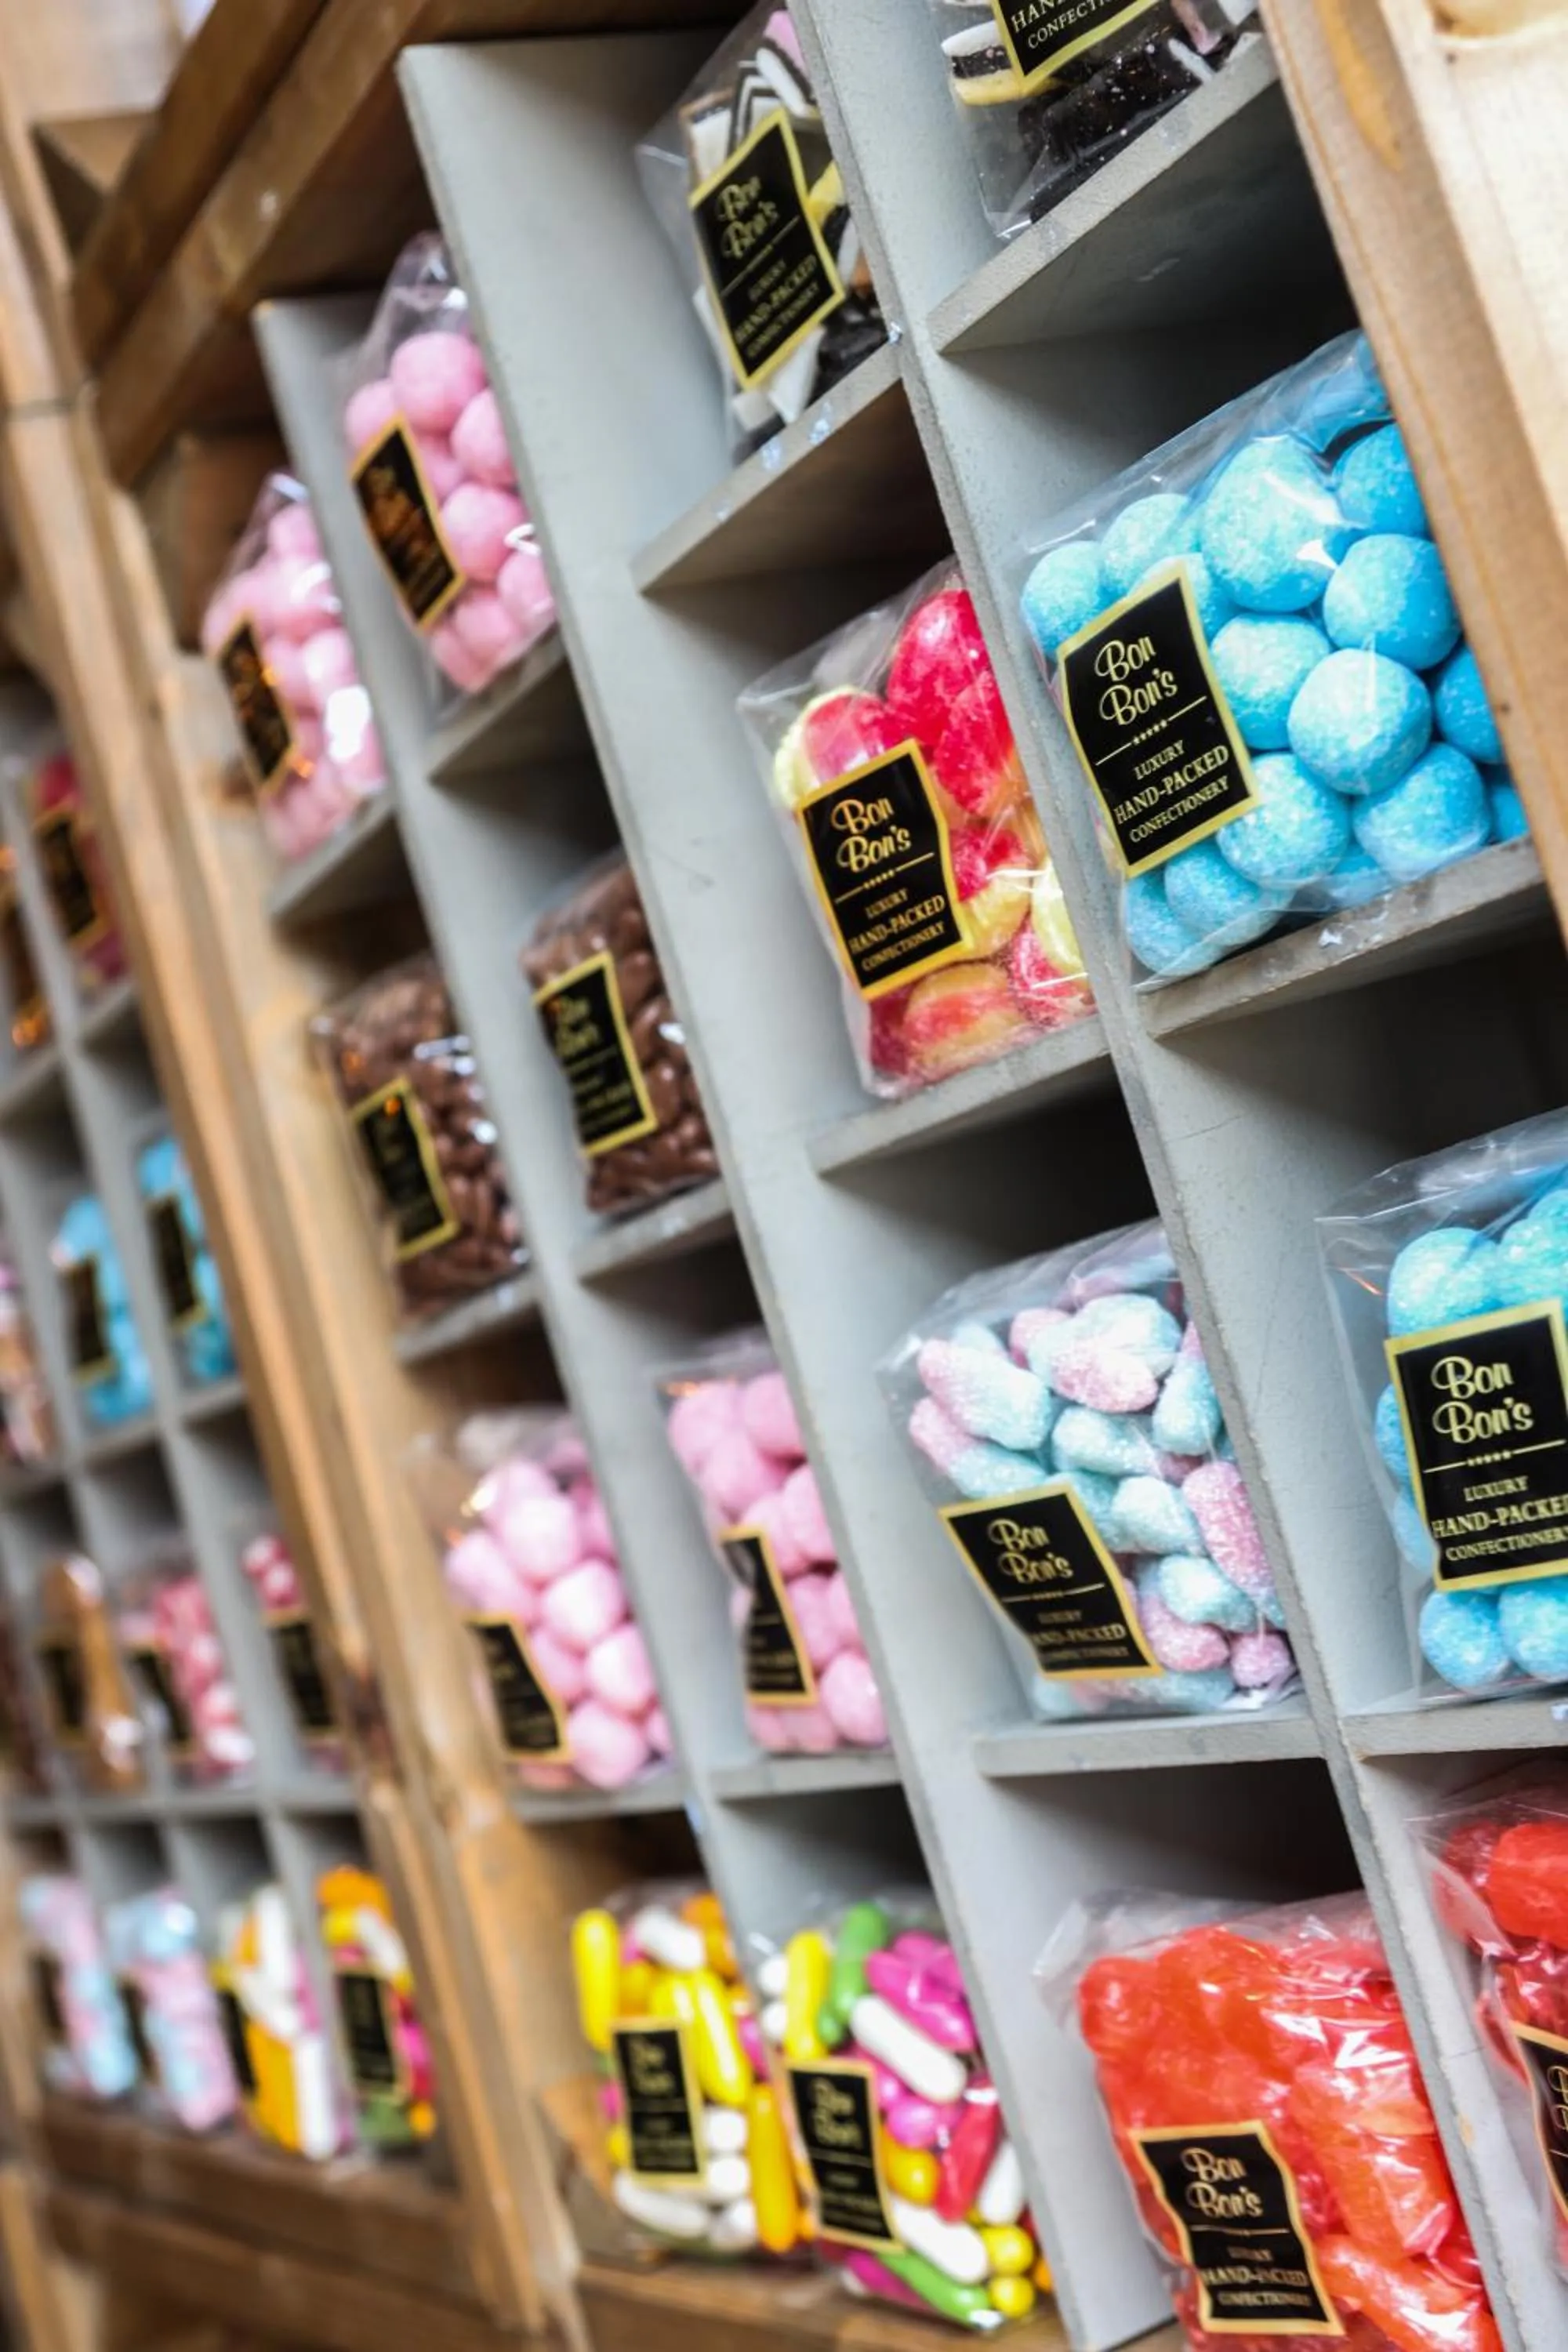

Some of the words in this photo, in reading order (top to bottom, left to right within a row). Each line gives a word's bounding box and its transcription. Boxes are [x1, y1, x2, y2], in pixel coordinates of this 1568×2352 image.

[1028, 0, 1111, 49] CONFECT
[1094, 637, 1156, 681] Bon
[1100, 668, 1178, 725] Bon's
[1134, 740, 1185, 780] LUXURY
[1114, 745, 1229, 825] HAND-PACKED
[832, 798, 895, 834] Bon
[1129, 775, 1229, 843] CONFECTIONERY
[837, 826, 911, 873] Bon's
[848, 895, 945, 954] HAND-PACKED
[1431, 1356, 1514, 1399] Bon
[1432, 1398, 1534, 1444] Bon's
[1464, 1475, 1529, 1501] LUXURY
[988, 1519, 1050, 1552] Bon
[999, 1552, 1073, 1584] Bon's
[1181, 2147, 1247, 2183] Bon
[1185, 2182, 1263, 2217] Bon's
